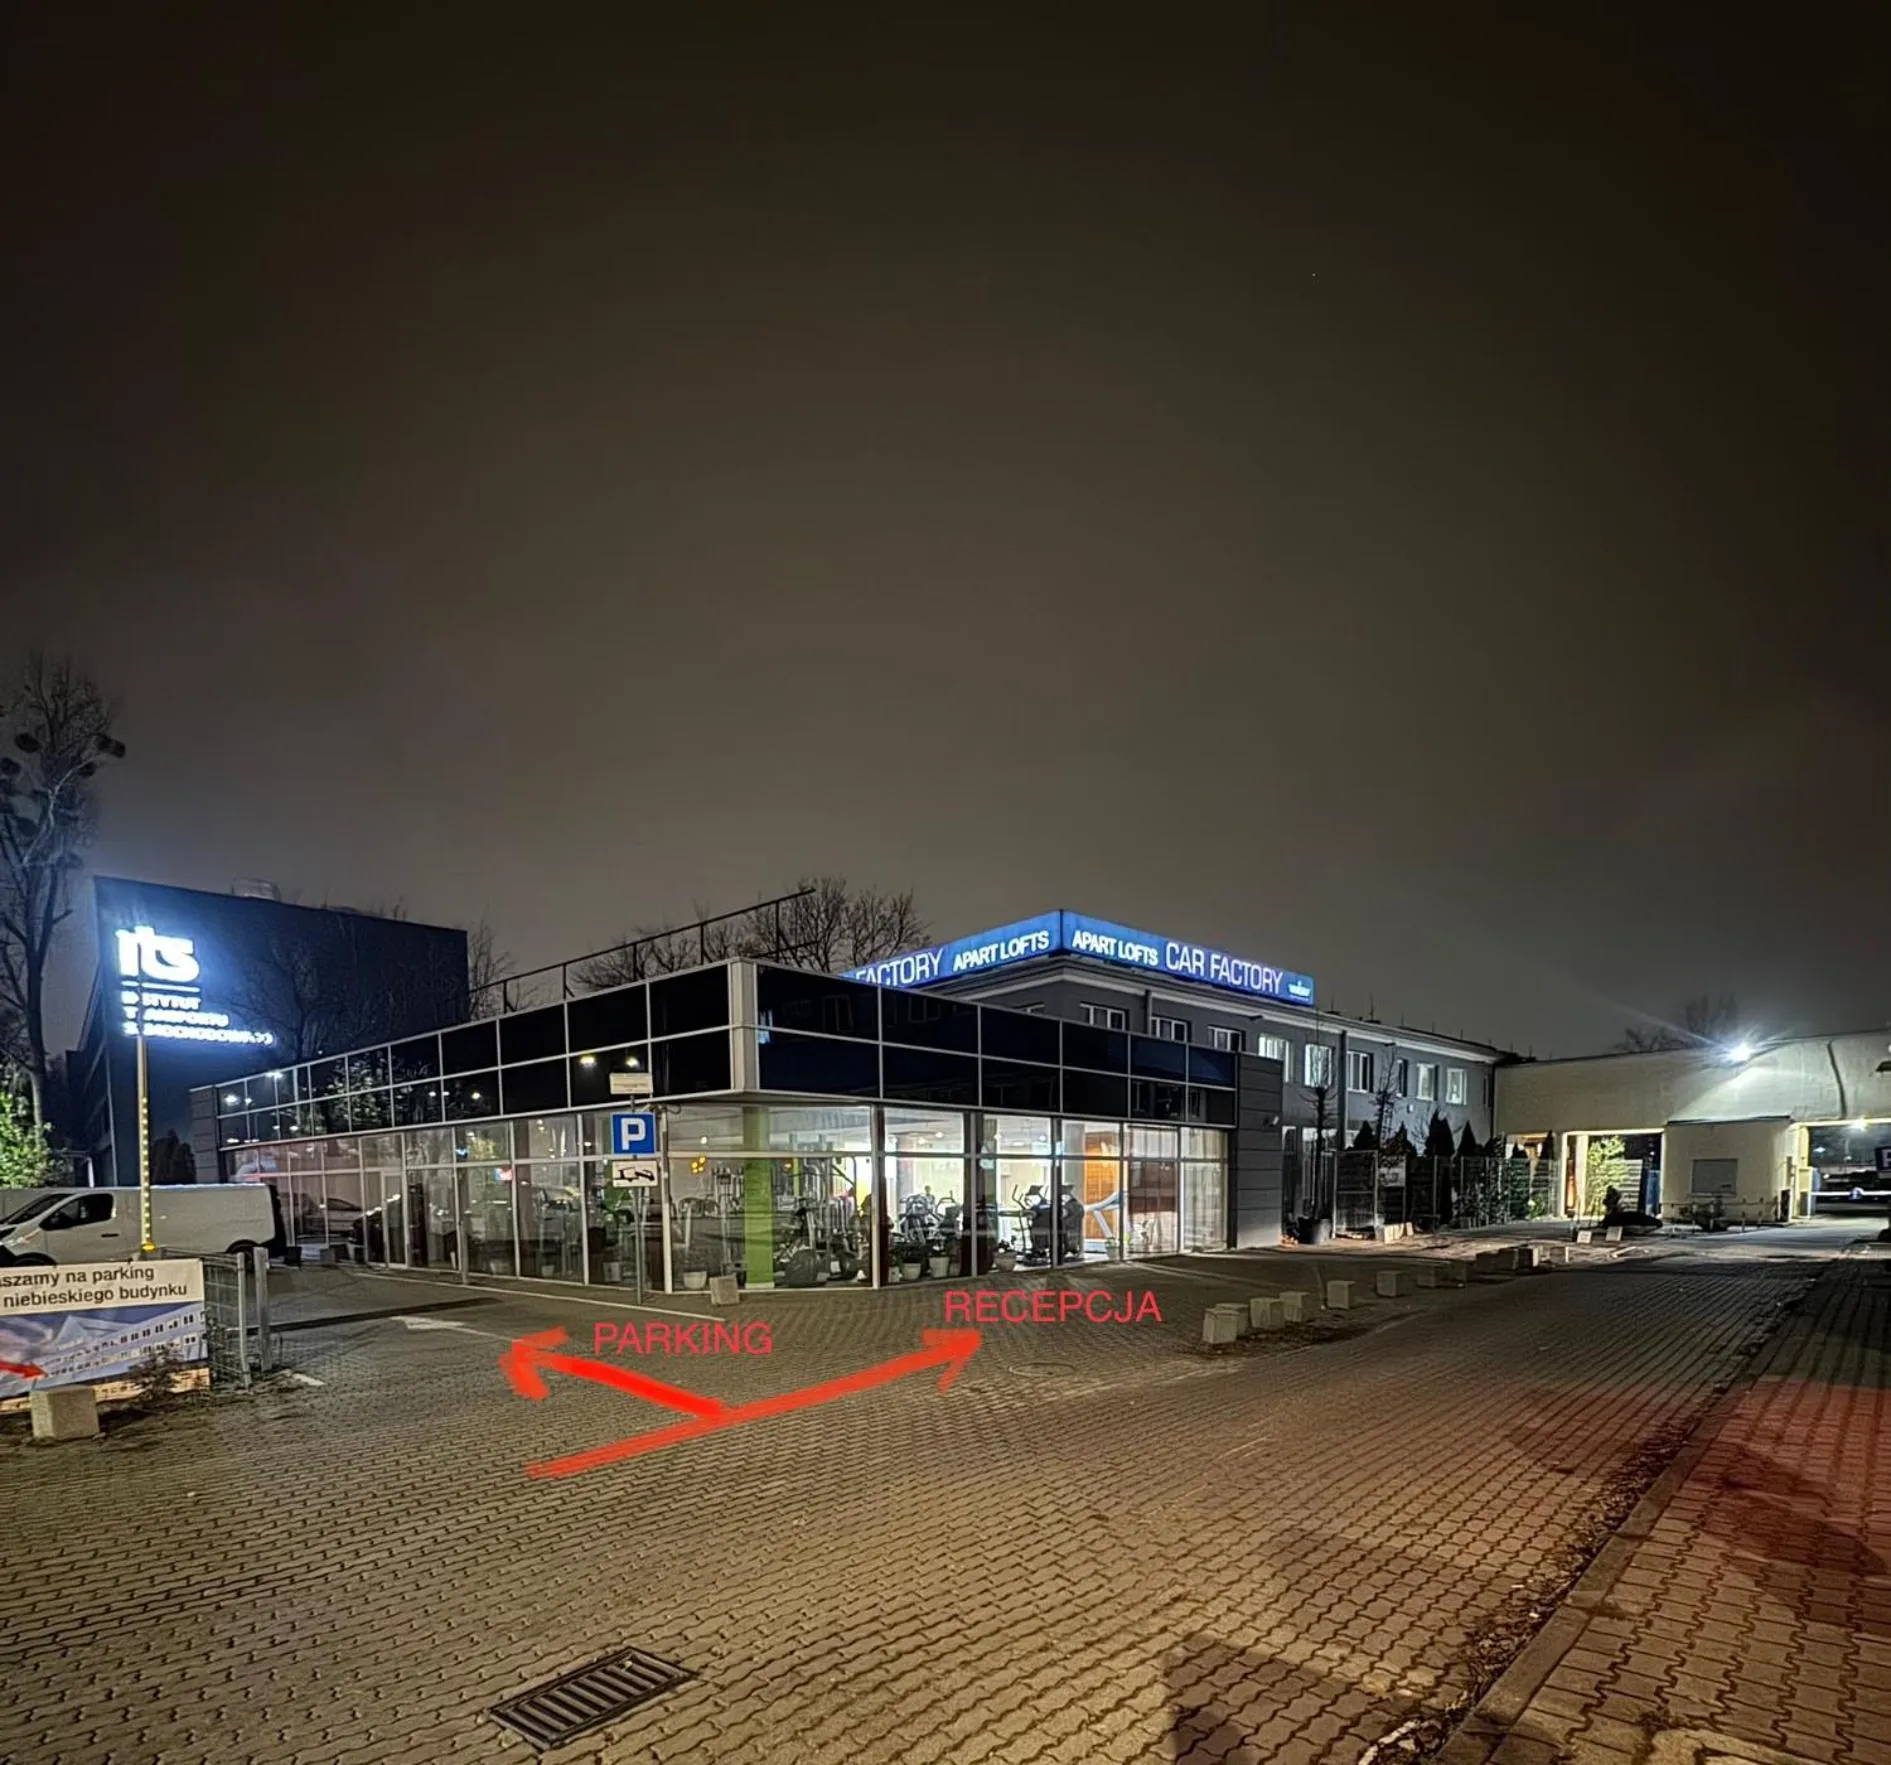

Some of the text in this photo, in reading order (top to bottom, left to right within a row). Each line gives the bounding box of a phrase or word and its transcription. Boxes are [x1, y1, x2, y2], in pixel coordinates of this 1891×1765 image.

[953, 943, 999, 972] APART
[1000, 930, 1050, 960] LOFTS
[1072, 930, 1117, 956] APART
[1117, 940, 1159, 967] LOFTS
[1165, 942, 1206, 979] CAR
[1210, 954, 1284, 995] FACTORY
[620, 1117, 647, 1151] P
[66, 1271, 87, 1283] na
[92, 1265, 154, 1284] parking
[3, 1283, 187, 1307] niebieskiego budynku
